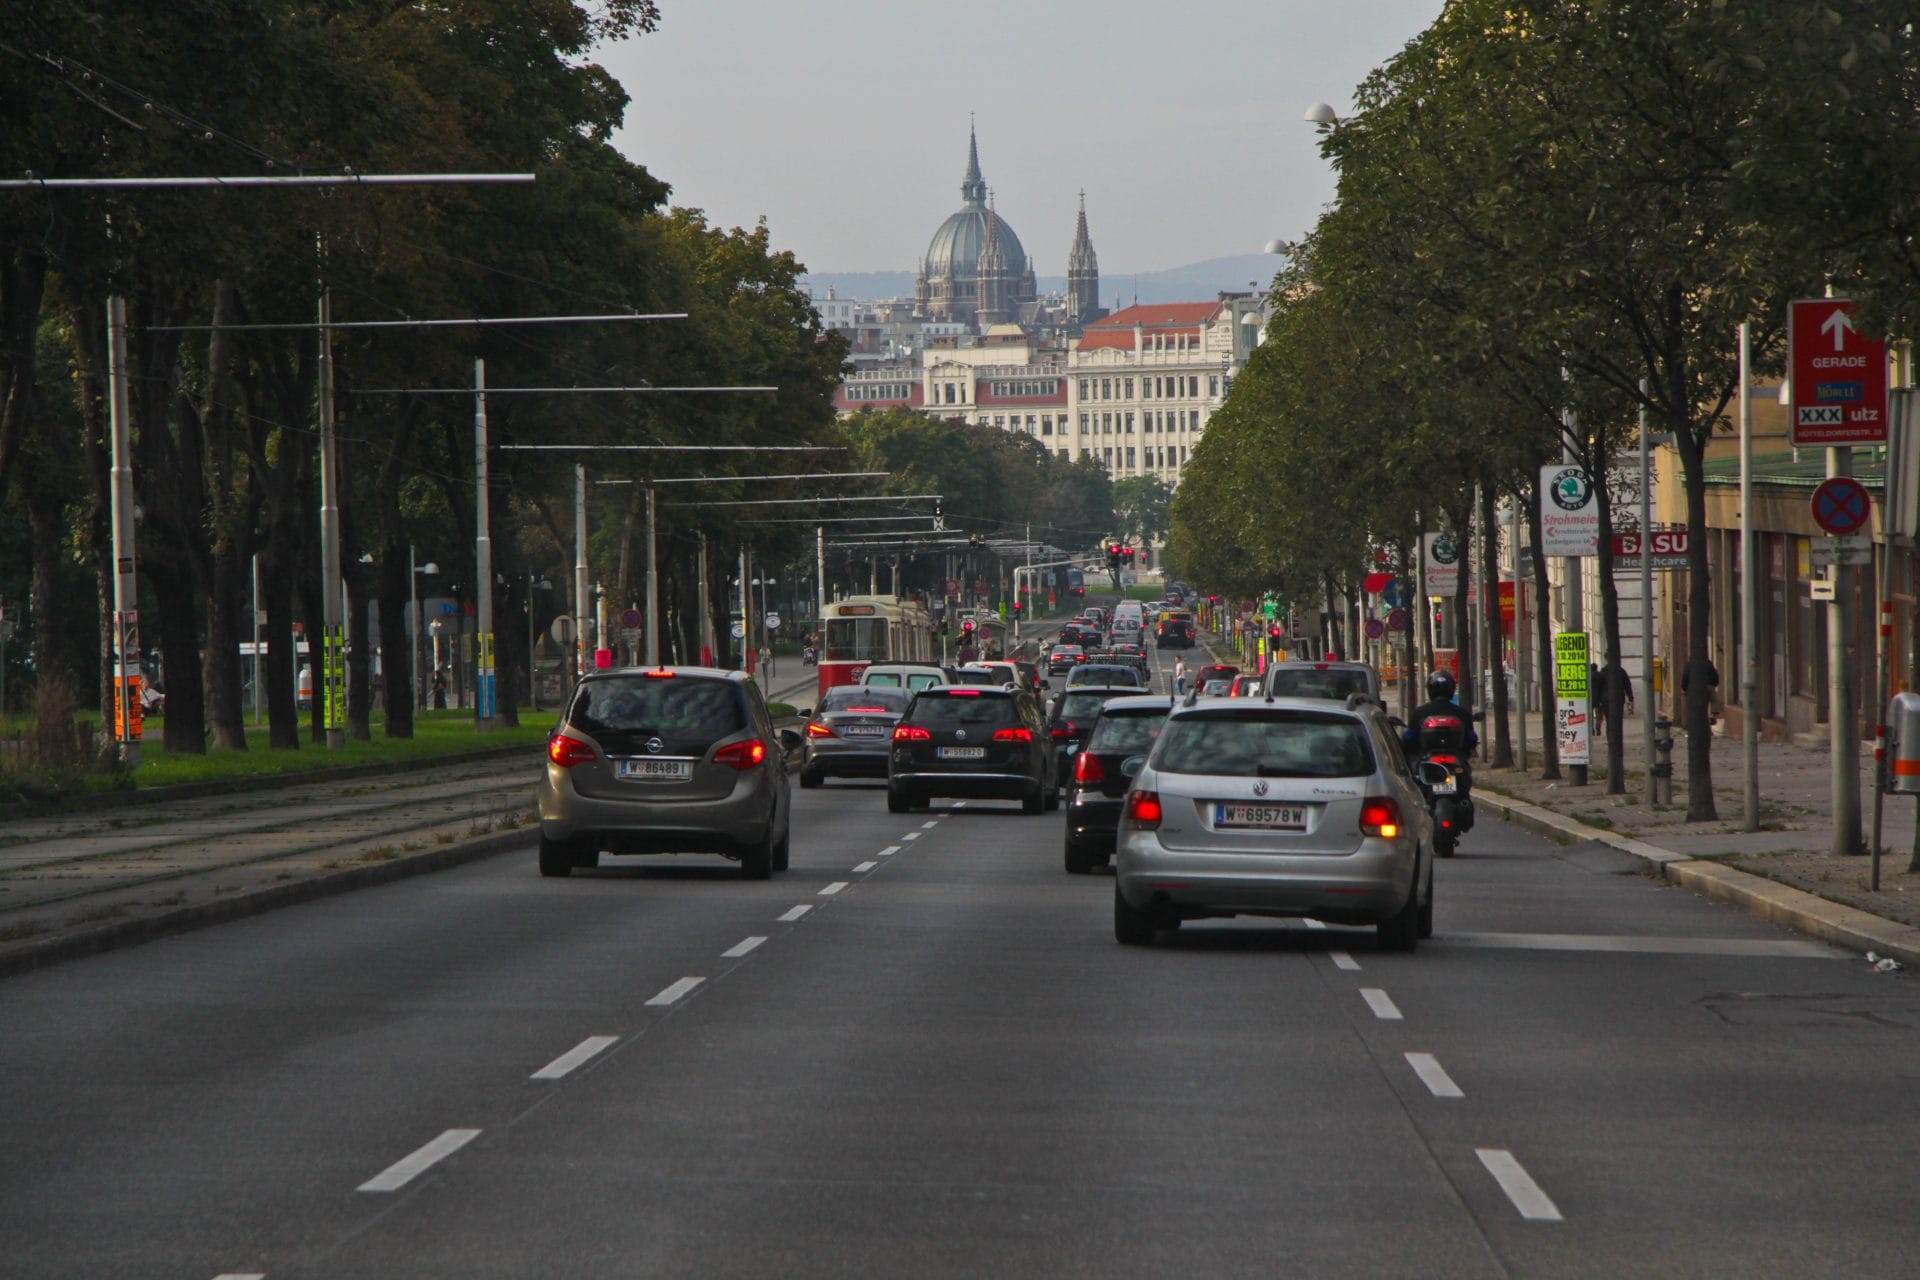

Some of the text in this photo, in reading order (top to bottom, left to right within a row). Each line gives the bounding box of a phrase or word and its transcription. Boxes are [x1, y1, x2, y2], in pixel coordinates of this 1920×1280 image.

[1812, 357, 1867, 368] GERADE
[1225, 807, 1303, 823] W 69578 W
